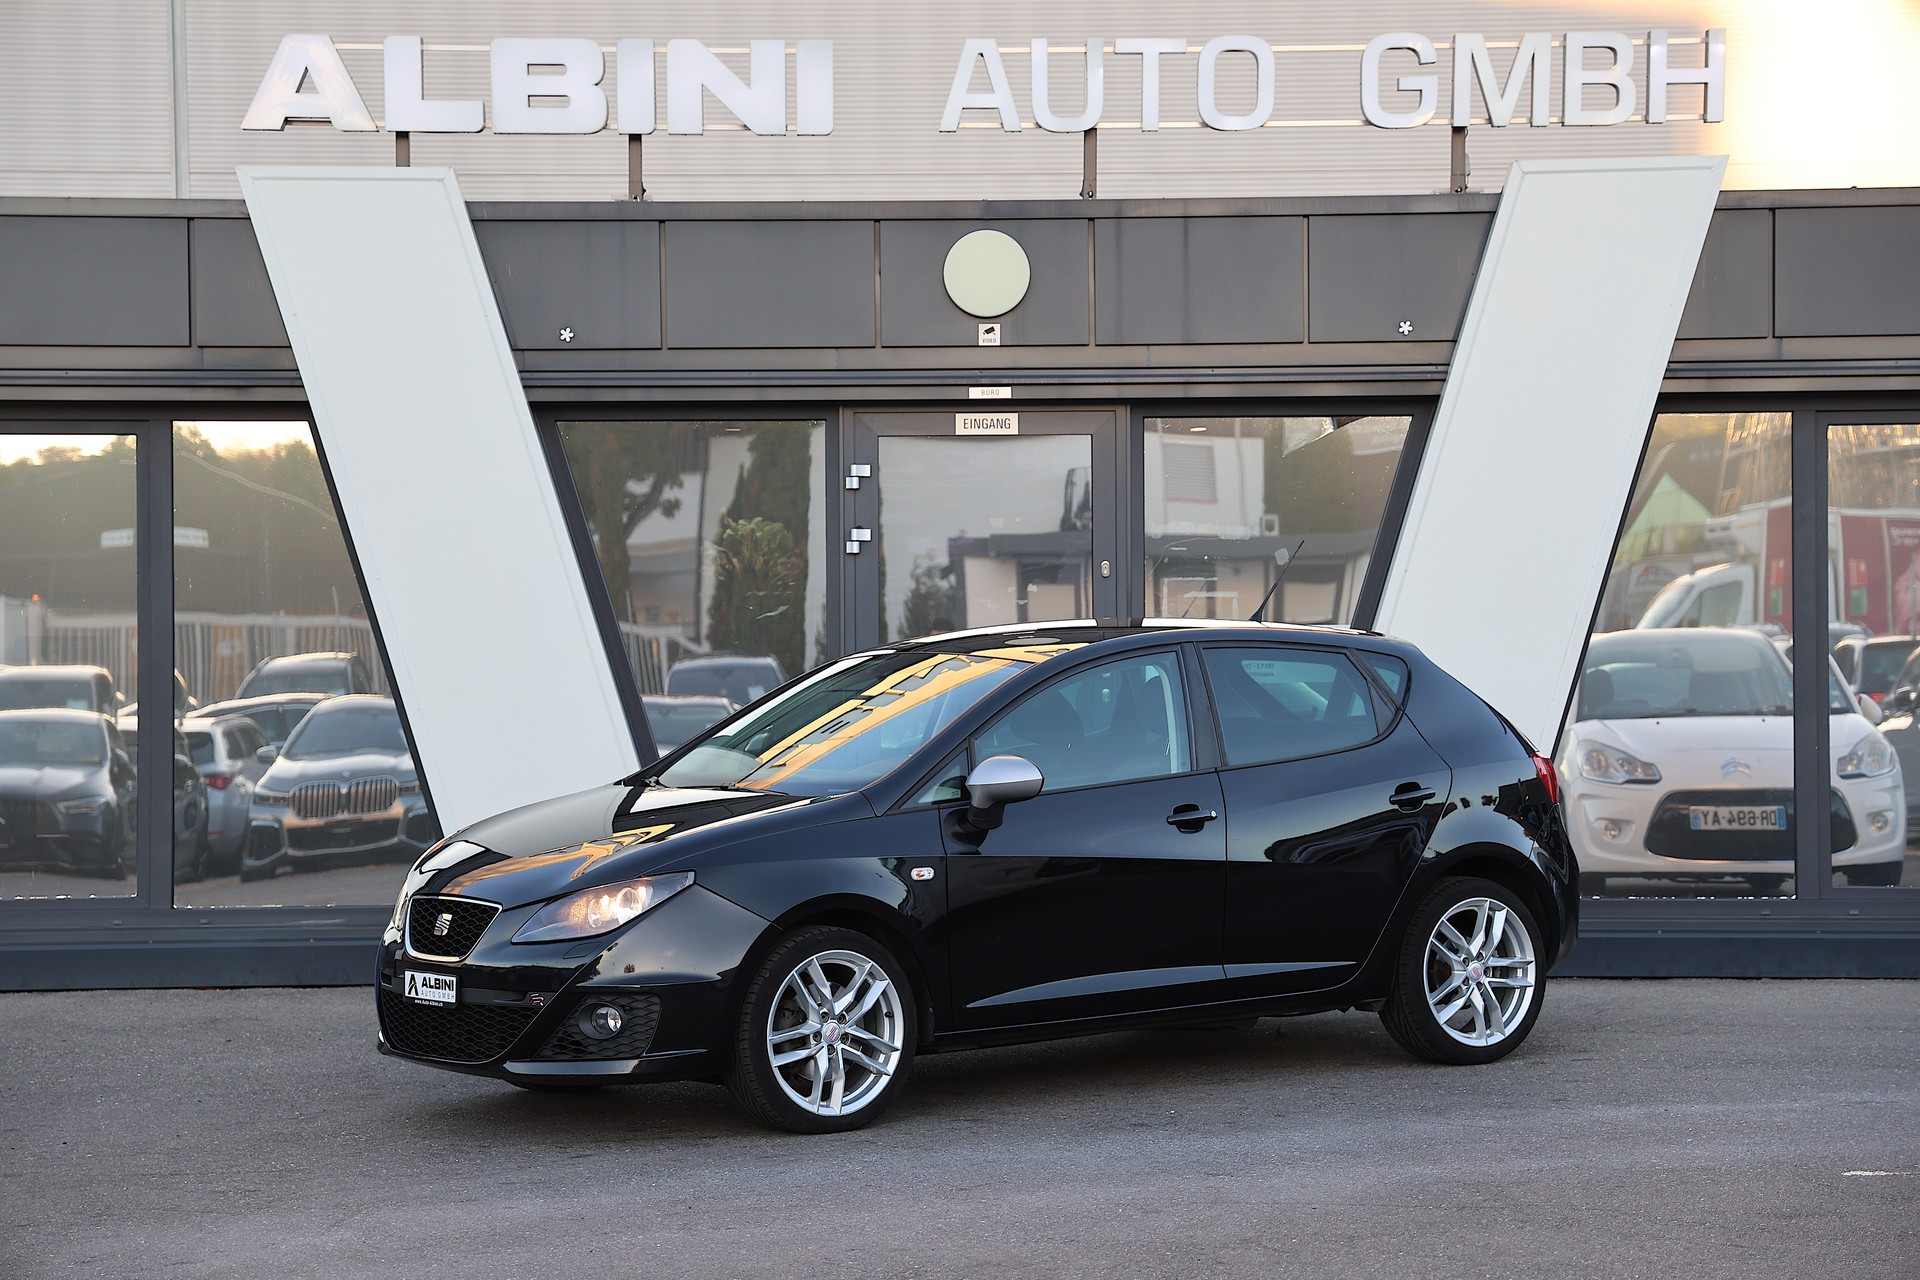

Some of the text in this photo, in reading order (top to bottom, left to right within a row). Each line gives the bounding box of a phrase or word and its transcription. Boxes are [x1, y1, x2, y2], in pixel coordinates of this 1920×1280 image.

[240, 28, 1726, 136] ALBINI AUTO GMBH
[963, 418, 1011, 430] EINGANG
[421, 976, 454, 992] ALBINI
[421, 990, 435, 998] AUTO
